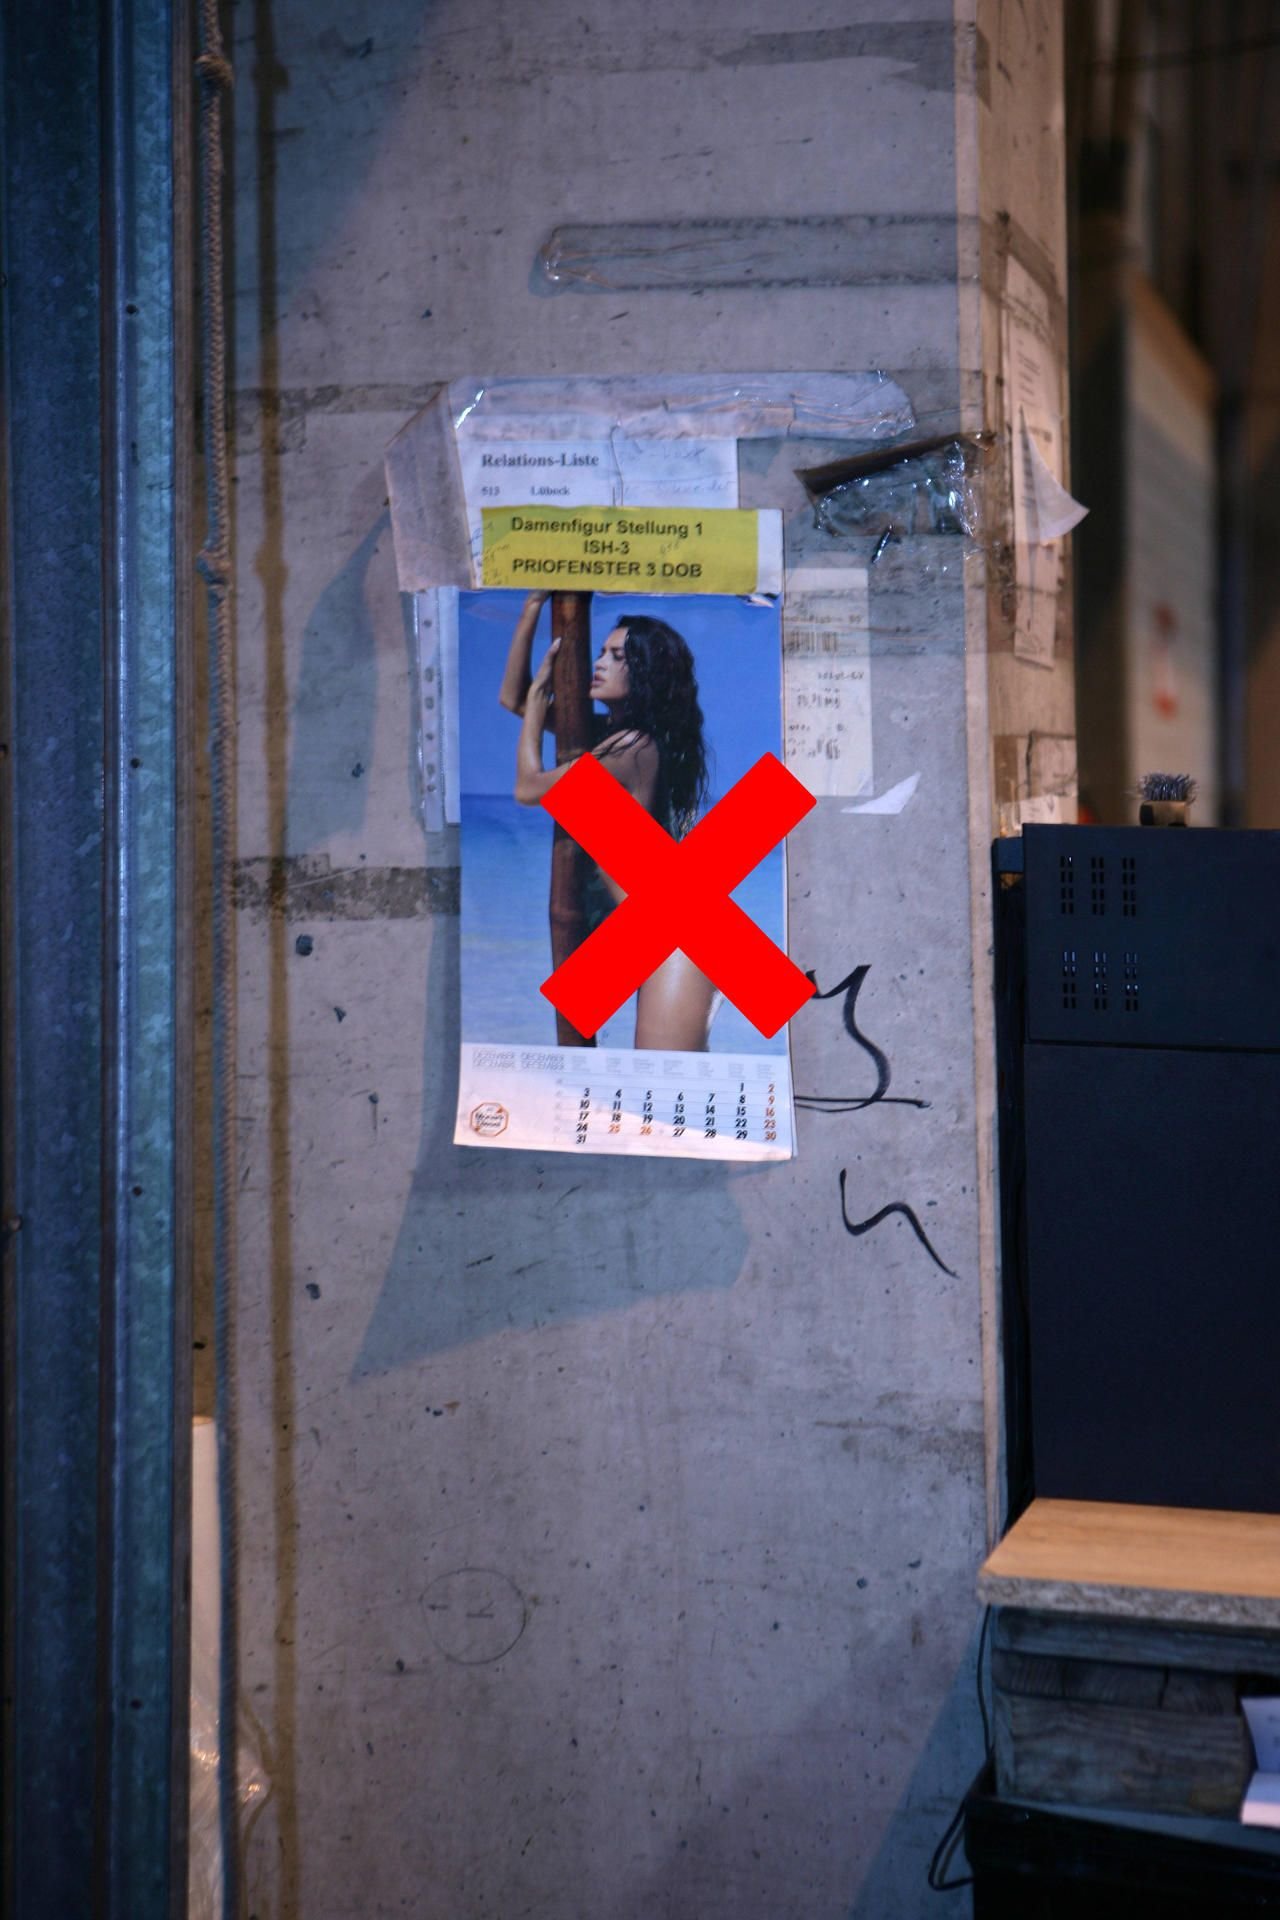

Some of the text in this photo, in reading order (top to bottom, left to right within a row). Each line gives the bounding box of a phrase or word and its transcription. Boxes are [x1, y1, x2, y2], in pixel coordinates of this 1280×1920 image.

[481, 453, 600, 468] Relations-Liste
[530, 485, 570, 497] Lübeck
[511, 516, 612, 536] Damenfigur
[616, 520, 689, 540] Stellung
[695, 523, 704, 536] 1
[583, 539, 631, 555] ISH-3
[511, 558, 703, 579] PRIOFENSTER 3 DOB
[740, 1082, 774, 1093] 1 2
[584, 1088, 775, 1105] 3 4 5 6 7 8 9
[580, 1099, 775, 1117] 10 11 12 13 14 15 16
[579, 1111, 776, 1129] 17 18 19 20 21 22 23
[576, 1123, 776, 1140] 24 25 26 27 28 29 30
[576, 1134, 587, 1144] 31
